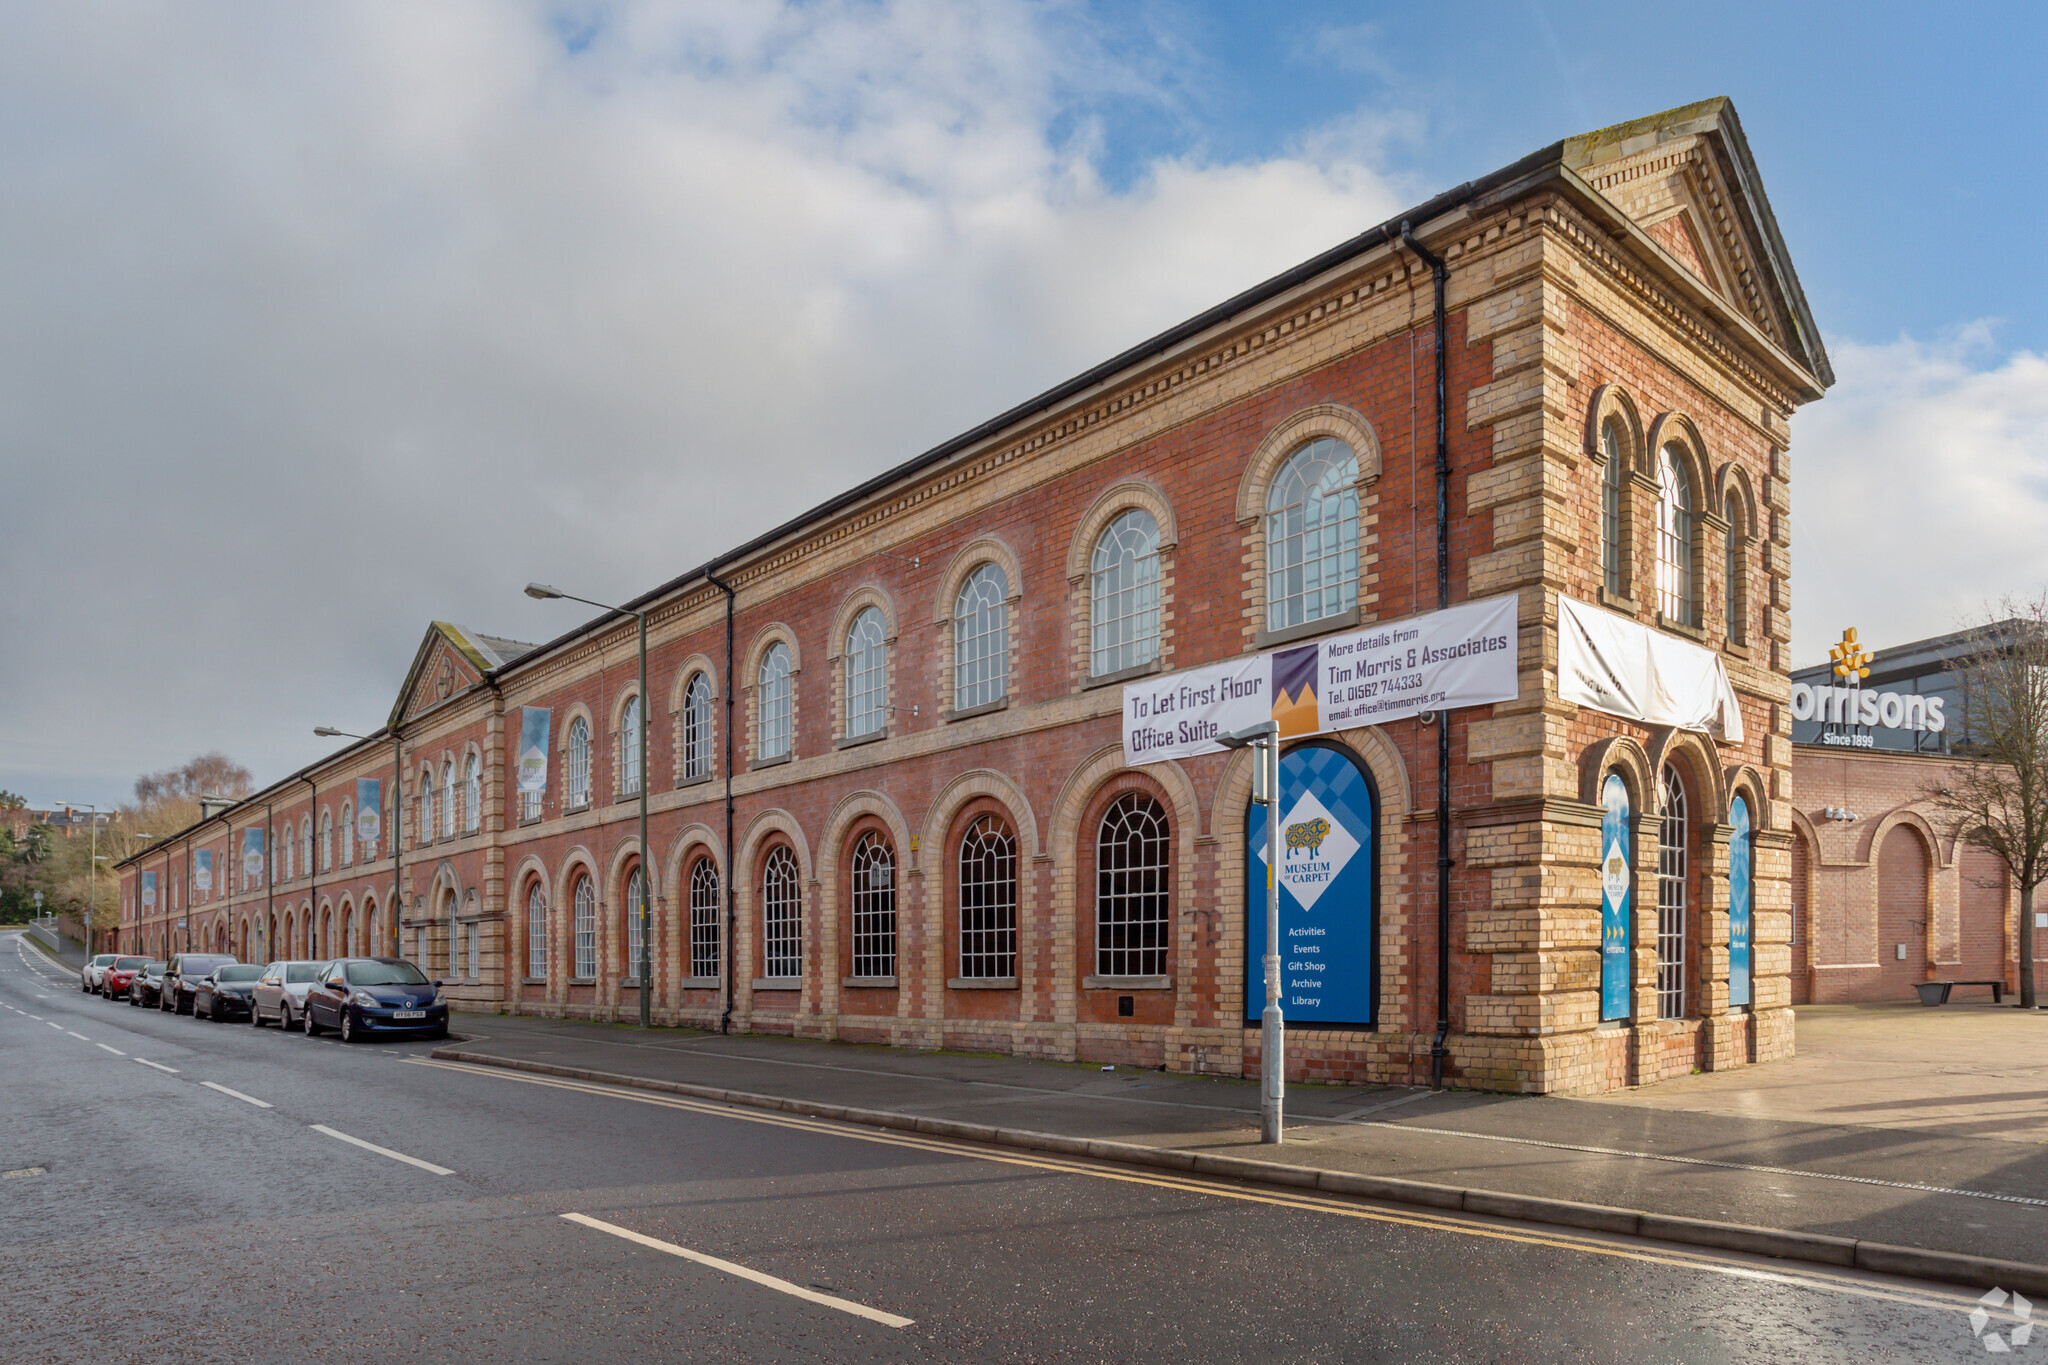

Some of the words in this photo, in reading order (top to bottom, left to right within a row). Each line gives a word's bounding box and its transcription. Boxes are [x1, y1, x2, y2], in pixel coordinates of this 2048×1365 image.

[1328, 644, 1354, 658] More
[1356, 633, 1390, 652] details
[1393, 629, 1419, 644] from
[1328, 666, 1352, 685] Tim
[1356, 655, 1402, 679] Morris
[1407, 648, 1416, 668] &
[1421, 635, 1507, 666] Associates
[1328, 690, 1345, 705] Tel.
[1347, 682, 1378, 701] 01562
[1380, 673, 1423, 694] 744333
[1132, 697, 1148, 719] To
[1152, 693, 1175, 715] Let
[1180, 684, 1215, 710] First
[1220, 676, 1262, 701] Floor
[1328, 710, 1352, 722] email:
[1354, 691, 1446, 717] office@timmorris.org
[1790, 682, 1946, 733] orrisons
[1132, 727, 1173, 752] Office
[1178, 720, 1218, 745] Suite
[1823, 732, 1851, 746] Since
[1851, 734, 1874, 748] 1899
[1285, 862, 1330, 874] MUSEUM
[1292, 872, 1330, 883] CARPET
[1289, 927, 1326, 936] Activities
[1294, 945, 1320, 953] Events
[1606, 946, 1626, 954] entrance
[1288, 962, 1303, 971] Gift
[1304, 962, 1326, 973] Shop
[1291, 979, 1322, 988] Archive
[1292, 996, 1321, 1007] Library
